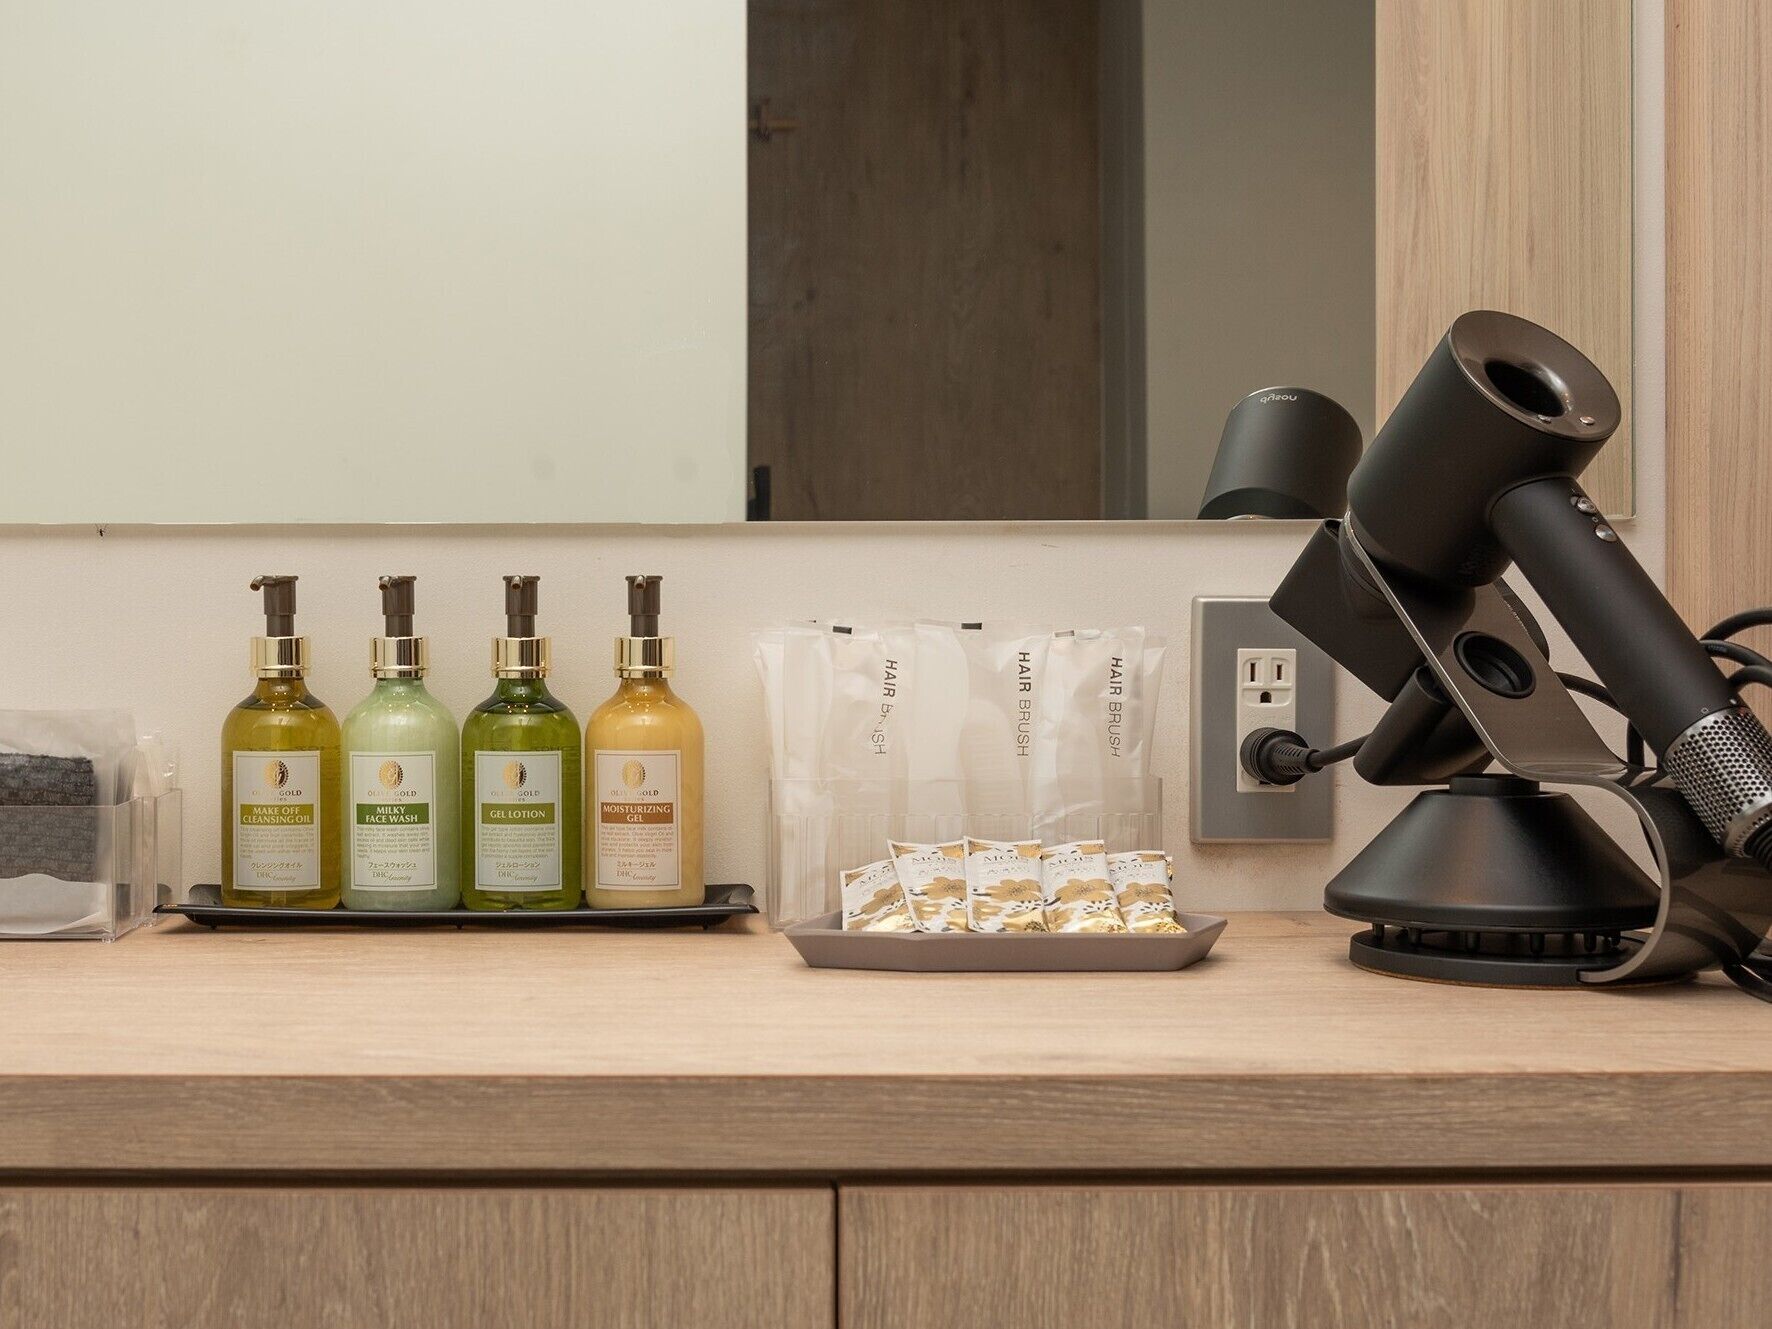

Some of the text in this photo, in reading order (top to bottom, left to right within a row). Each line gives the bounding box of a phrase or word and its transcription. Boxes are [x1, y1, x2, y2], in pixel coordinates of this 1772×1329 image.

[871, 659, 898, 755] HAIR BSH
[1017, 652, 1031, 756] HAIR BRUSH
[1107, 657, 1123, 757] HAIR BRUSH
[252, 806, 300, 815] MAKE OFF
[376, 806, 406, 814] MILKY
[490, 809, 546, 819] GEL LOTION
[602, 805, 671, 814] MOISTURIZING
[242, 815, 312, 824] CLEANSING OIL
[365, 814, 418, 823] FACE WASH
[626, 813, 644, 822] GEL
